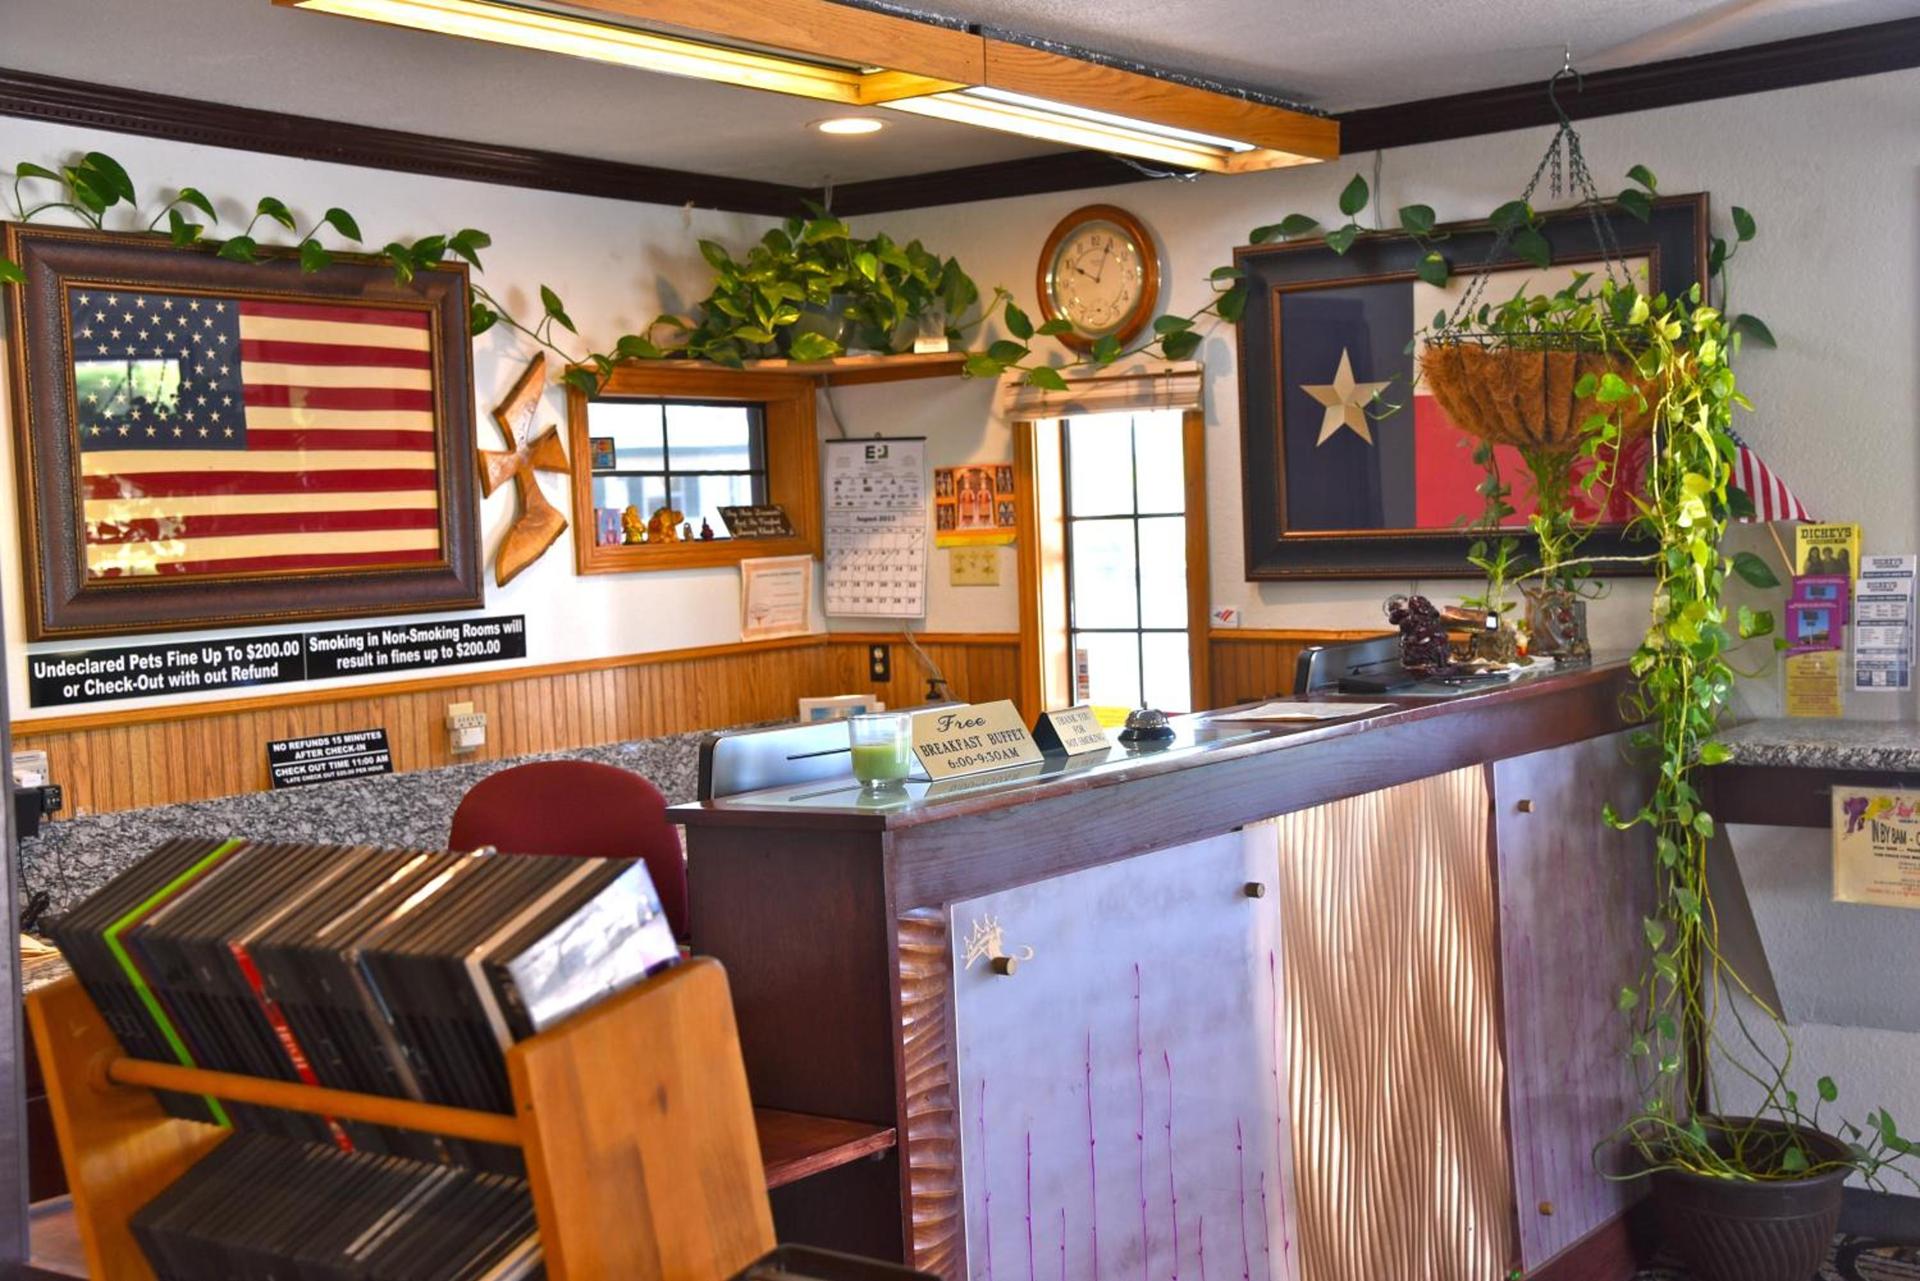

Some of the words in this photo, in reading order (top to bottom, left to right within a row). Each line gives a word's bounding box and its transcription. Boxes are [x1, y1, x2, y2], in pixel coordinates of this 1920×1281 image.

[309, 633, 364, 652] Smoking
[367, 632, 379, 647] in
[382, 625, 460, 646] Non-Smoking
[463, 623, 500, 638] Rooms
[503, 619, 523, 634] will
[33, 654, 125, 679] Undeclared
[129, 653, 163, 670] Pets
[167, 650, 198, 667] Fine
[202, 648, 222, 667] Up
[225, 646, 243, 661] To
[246, 640, 300, 661] $200.00
[337, 652, 374, 670] result
[376, 650, 388, 666] in
[391, 649, 421, 665] fines
[424, 649, 438, 663] up
[441, 645, 454, 659] to
[456, 639, 501, 658] $200.00
[63, 684, 80, 698] or
[84, 674, 165, 696] Check-Out
[168, 669, 200, 688] with
[204, 670, 228, 684] out
[231, 662, 279, 682] Refund
[937, 714, 987, 733] Free
[273, 743, 287, 752] NO
[288, 737, 330, 750] REFUNDS
[332, 736, 343, 744] 15
[344, 731, 383, 743] MINUTES
[295, 750, 324, 760] AFTER
[325, 743, 367, 756] CHECK-IN
[919, 735, 983, 758] BREAKFAST
[987, 728, 1026, 746] BUFFET
[275, 766, 307, 777] CHECK
[308, 763, 327, 773] OUT
[328, 759, 350, 770] TIME
[352, 757, 374, 767] 11:00
[376, 754, 389, 763] AM
[302, 773, 321, 782] CHECK
[323, 771, 335, 779] OUT
